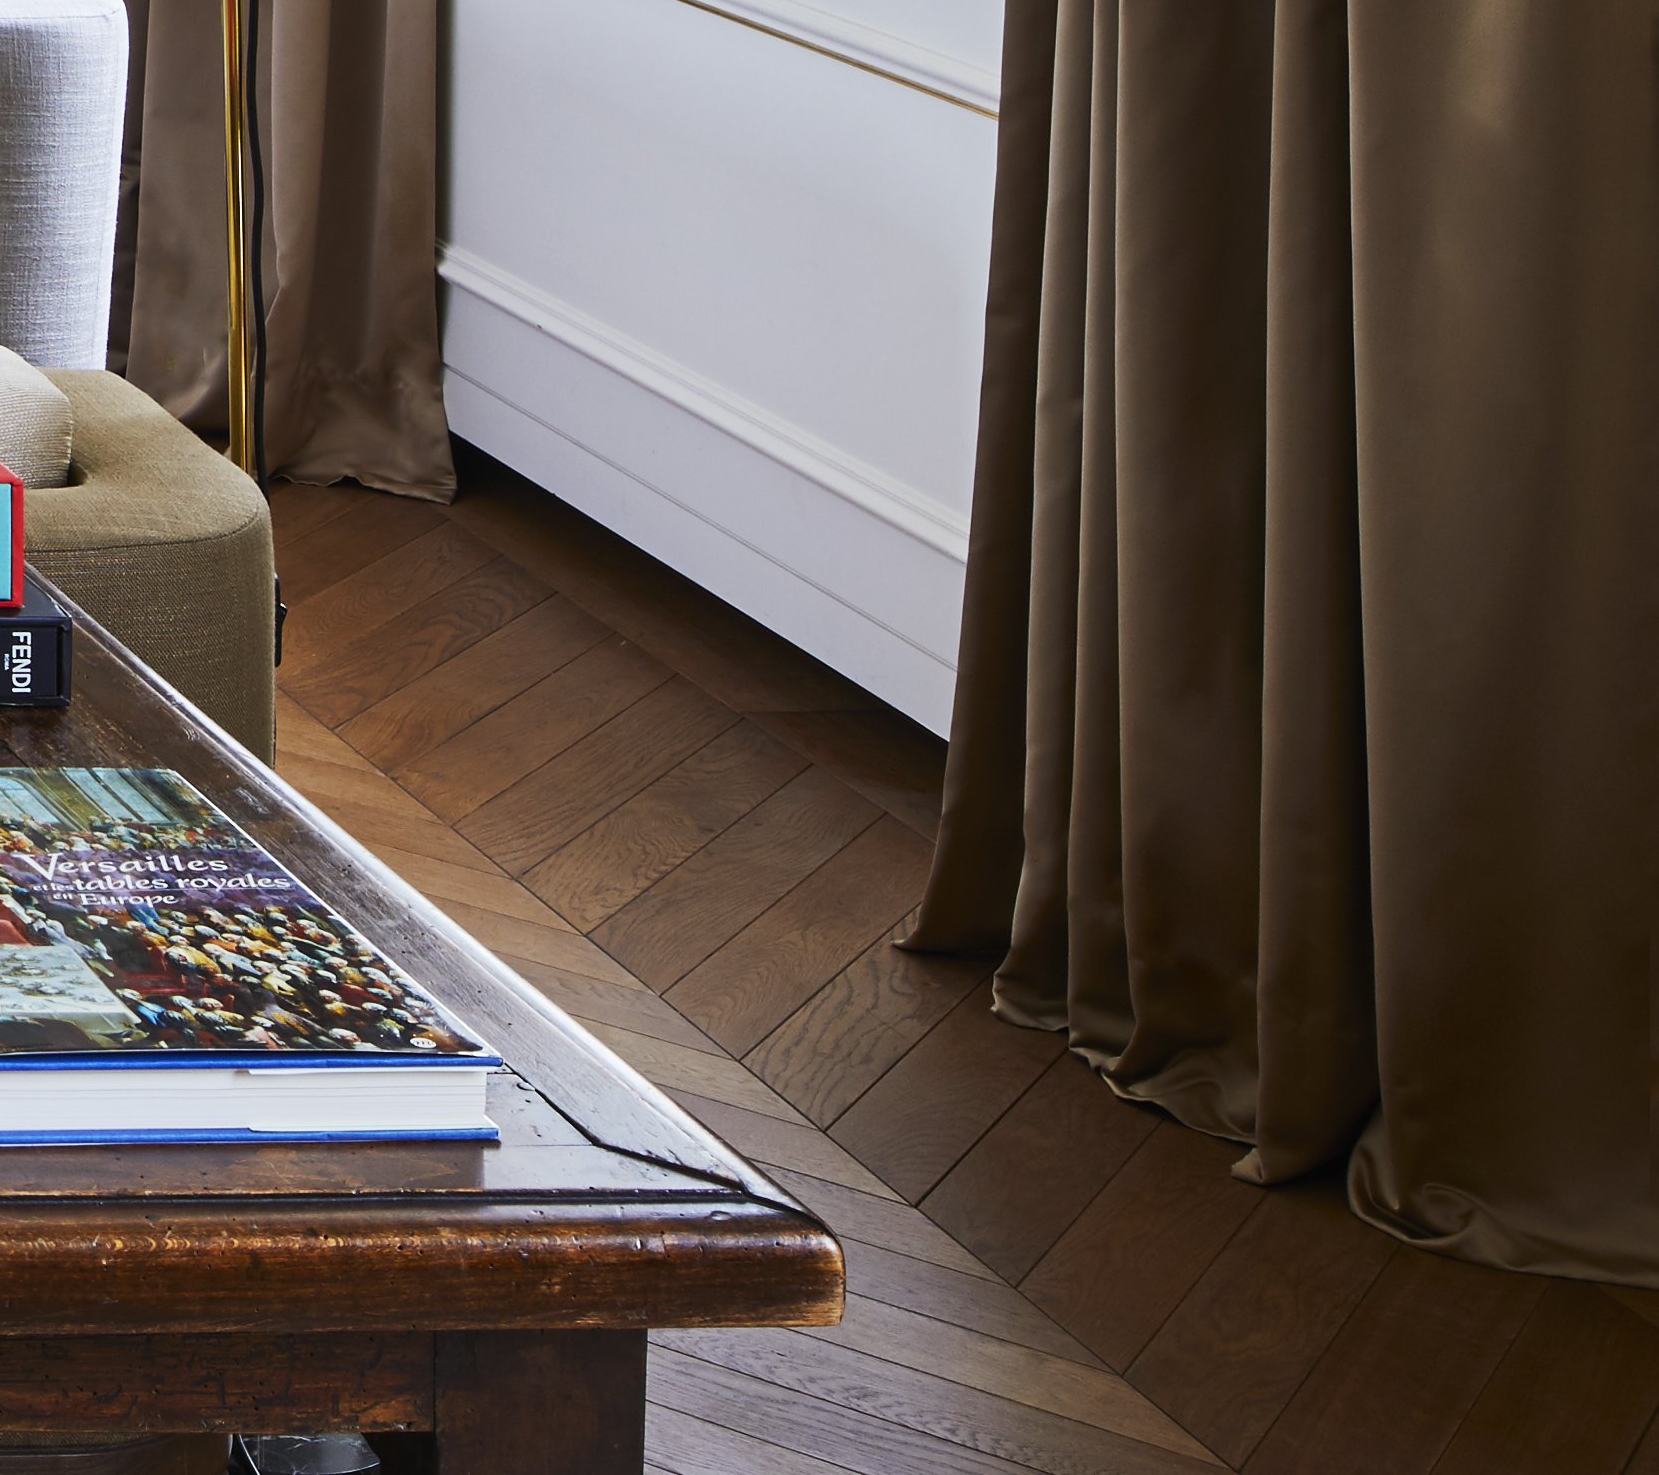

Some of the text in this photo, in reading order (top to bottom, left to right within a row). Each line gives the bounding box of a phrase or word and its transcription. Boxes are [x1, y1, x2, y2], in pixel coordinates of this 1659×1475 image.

[2, 652, 11, 672] ROMA
[11, 630, 32, 695] FENDI
[22, 852, 228, 882] Versailles
[32, 874, 291, 896] et les tables royales
[53, 891, 179, 908] en Europe
